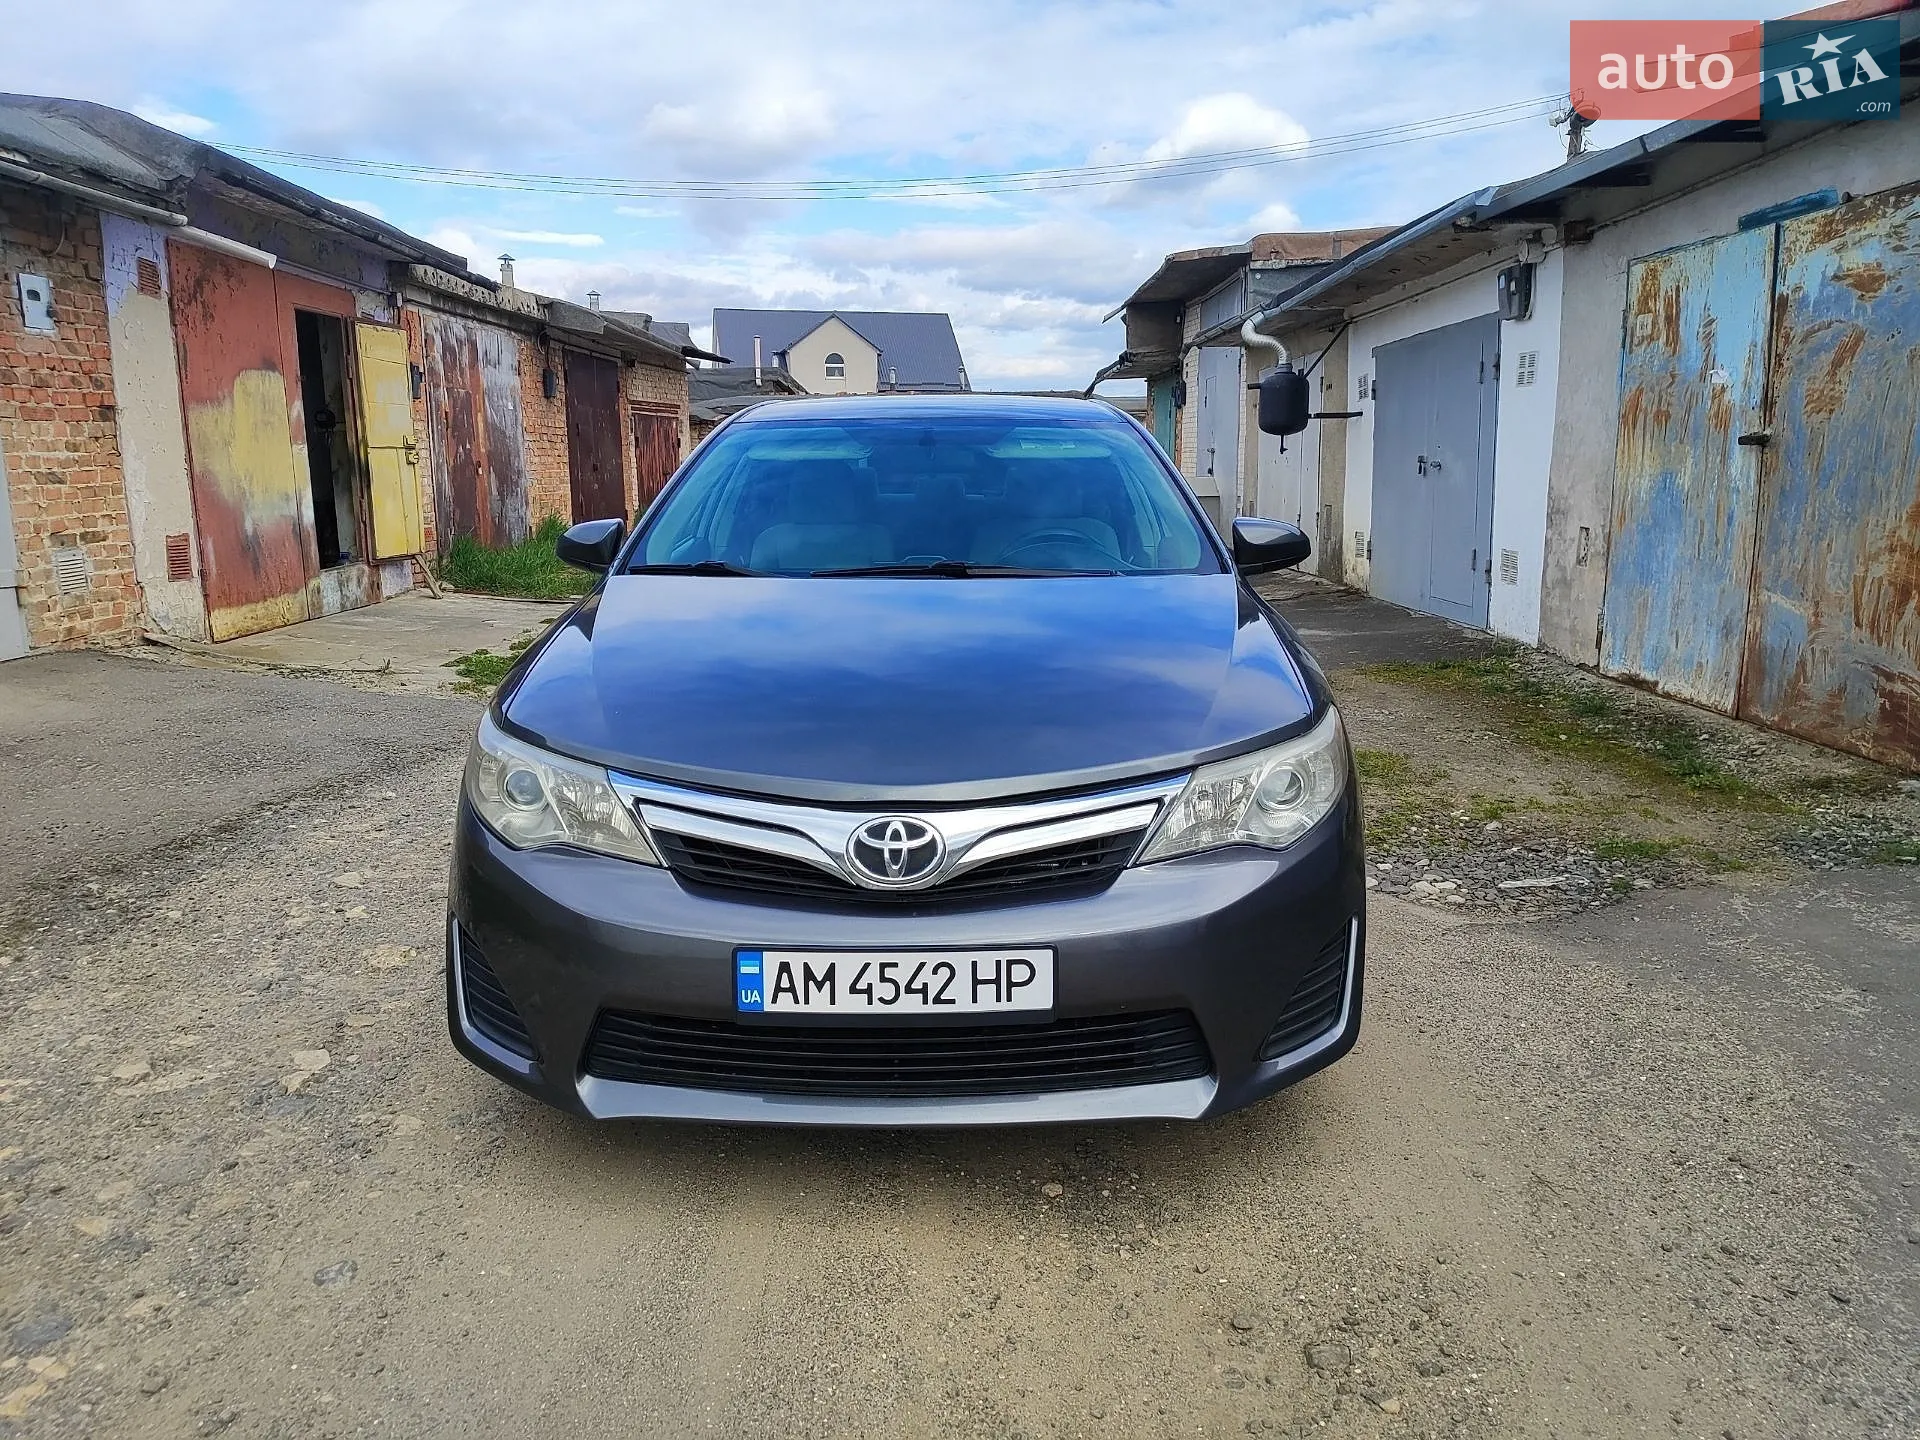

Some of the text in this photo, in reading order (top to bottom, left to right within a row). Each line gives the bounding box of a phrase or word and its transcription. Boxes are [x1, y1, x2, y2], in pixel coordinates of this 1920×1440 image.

[741, 989, 762, 1004] UA
[770, 958, 1037, 1006] AM 4542 HP
